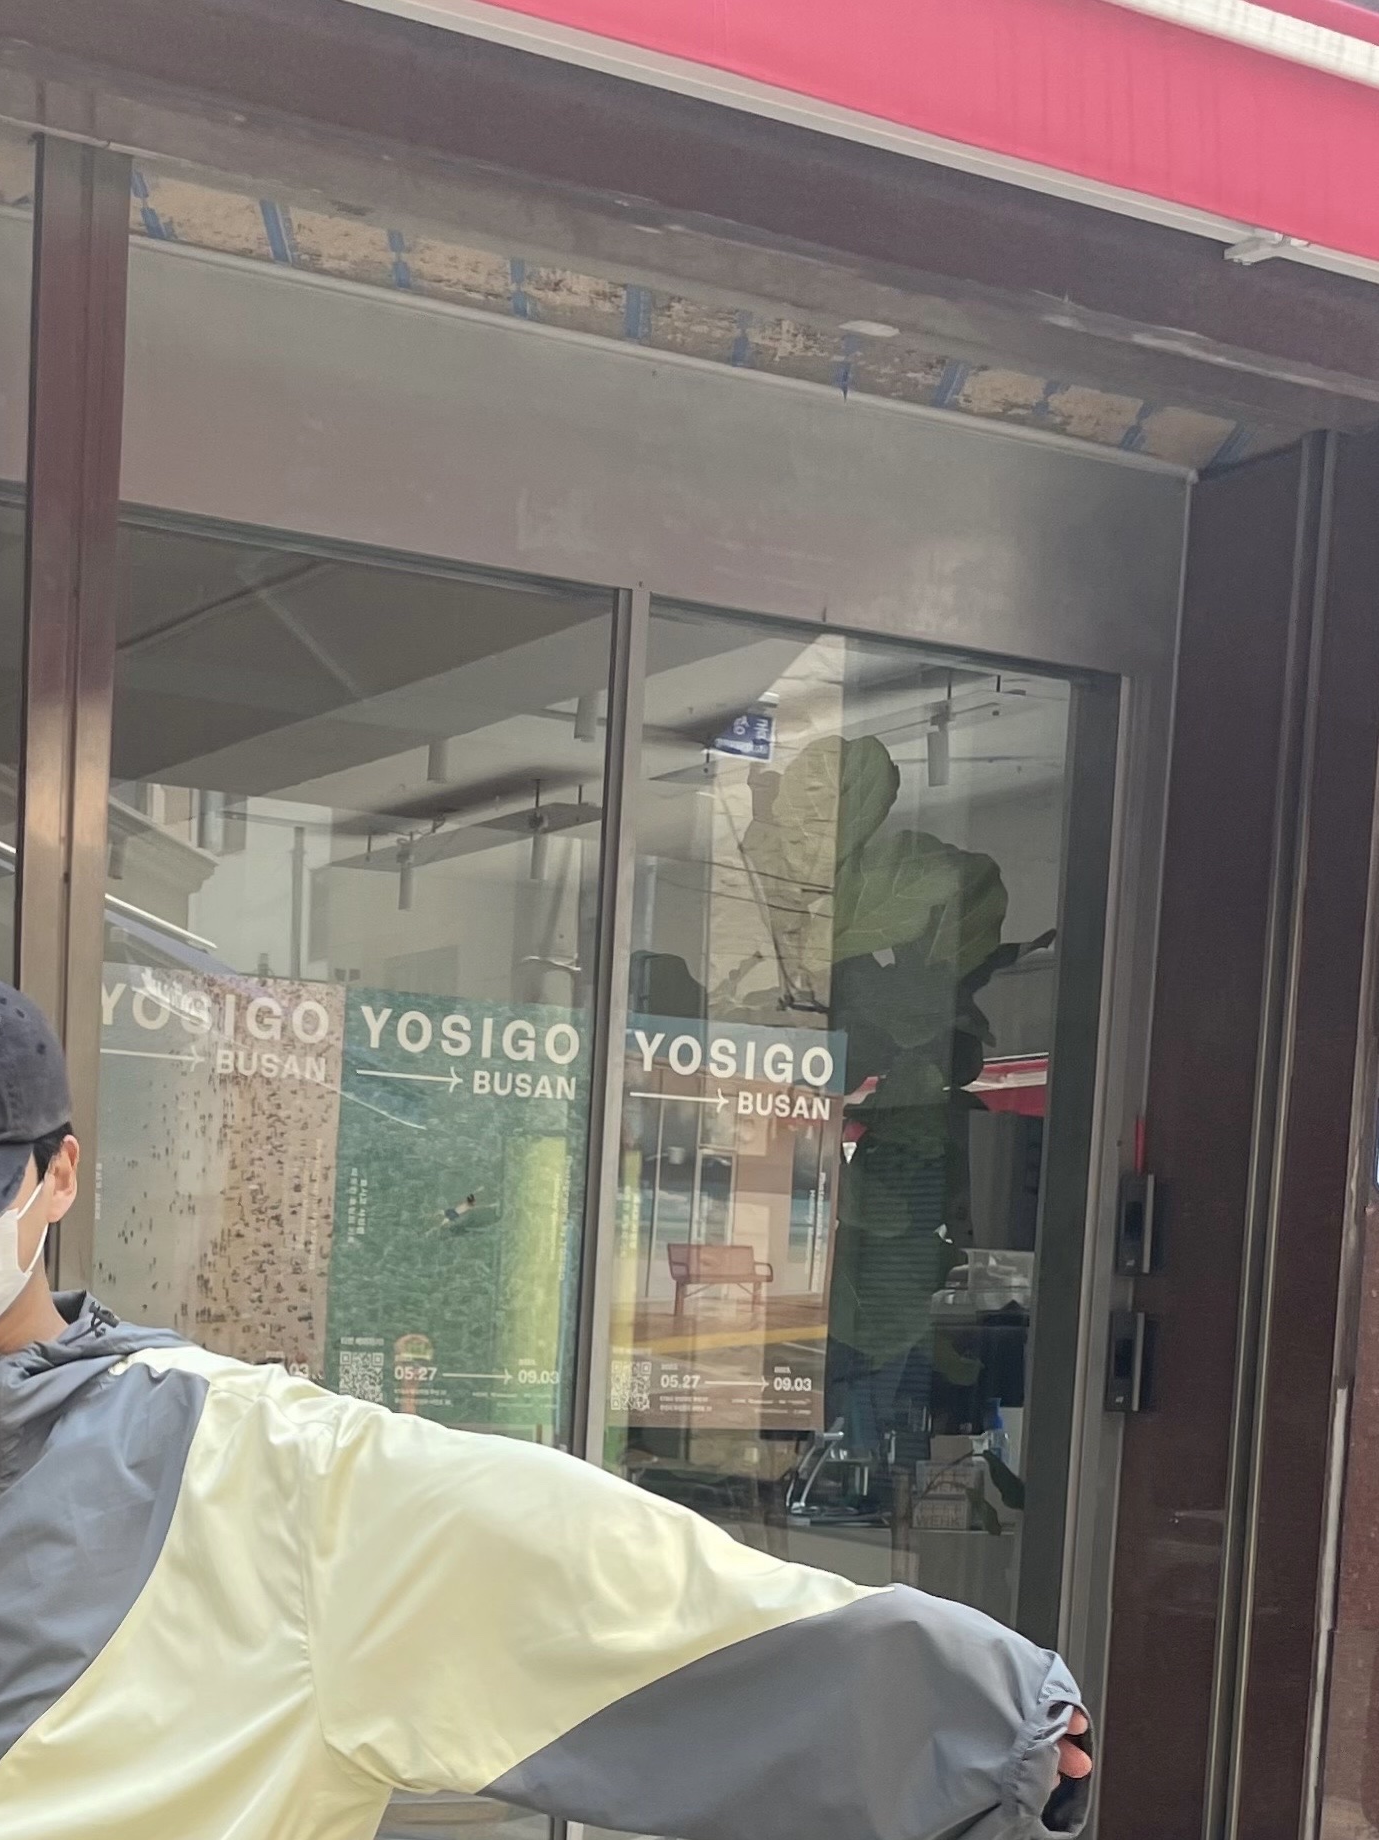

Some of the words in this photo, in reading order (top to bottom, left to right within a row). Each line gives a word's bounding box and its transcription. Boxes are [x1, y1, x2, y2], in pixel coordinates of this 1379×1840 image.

[101, 982, 330, 1045] YOSIGO
[360, 1004, 581, 1065] YOSIGO
[216, 1049, 327, 1082] BUSAN
[634, 1030, 834, 1087] YOSIGO
[472, 1070, 577, 1100] BUSAN
[737, 1091, 831, 1121] BUSAN
[394, 1366, 438, 1382] 05.27
[518, 1370, 560, 1385] 09.03
[660, 1374, 701, 1389] 05.27
[773, 1377, 813, 1392] 09.03
